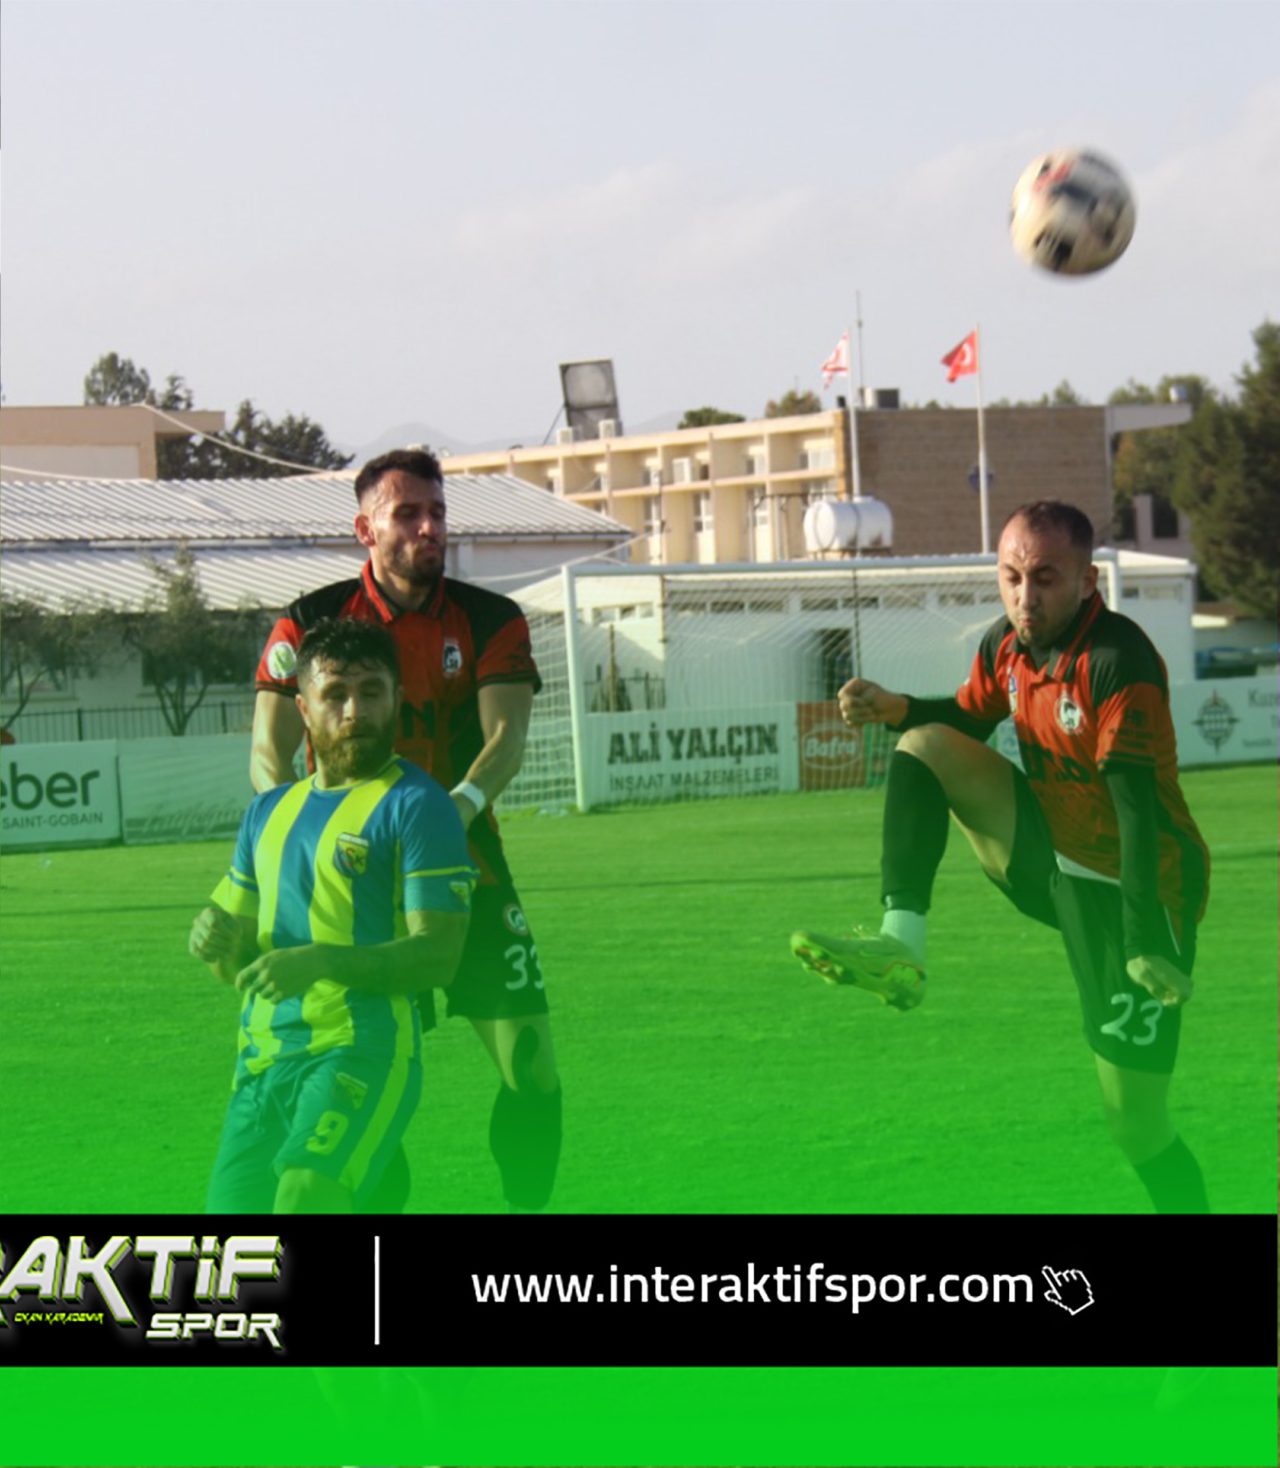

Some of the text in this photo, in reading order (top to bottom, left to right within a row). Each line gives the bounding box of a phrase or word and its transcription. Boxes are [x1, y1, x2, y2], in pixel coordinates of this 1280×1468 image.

[608, 722, 779, 765] ALİ YALÇIN
[0, 761, 101, 811] ber
[2, 812, 104, 830] SAINT-GOBAIN
[1101, 993, 1163, 1046] 23
[306, 1110, 348, 1155] 9
